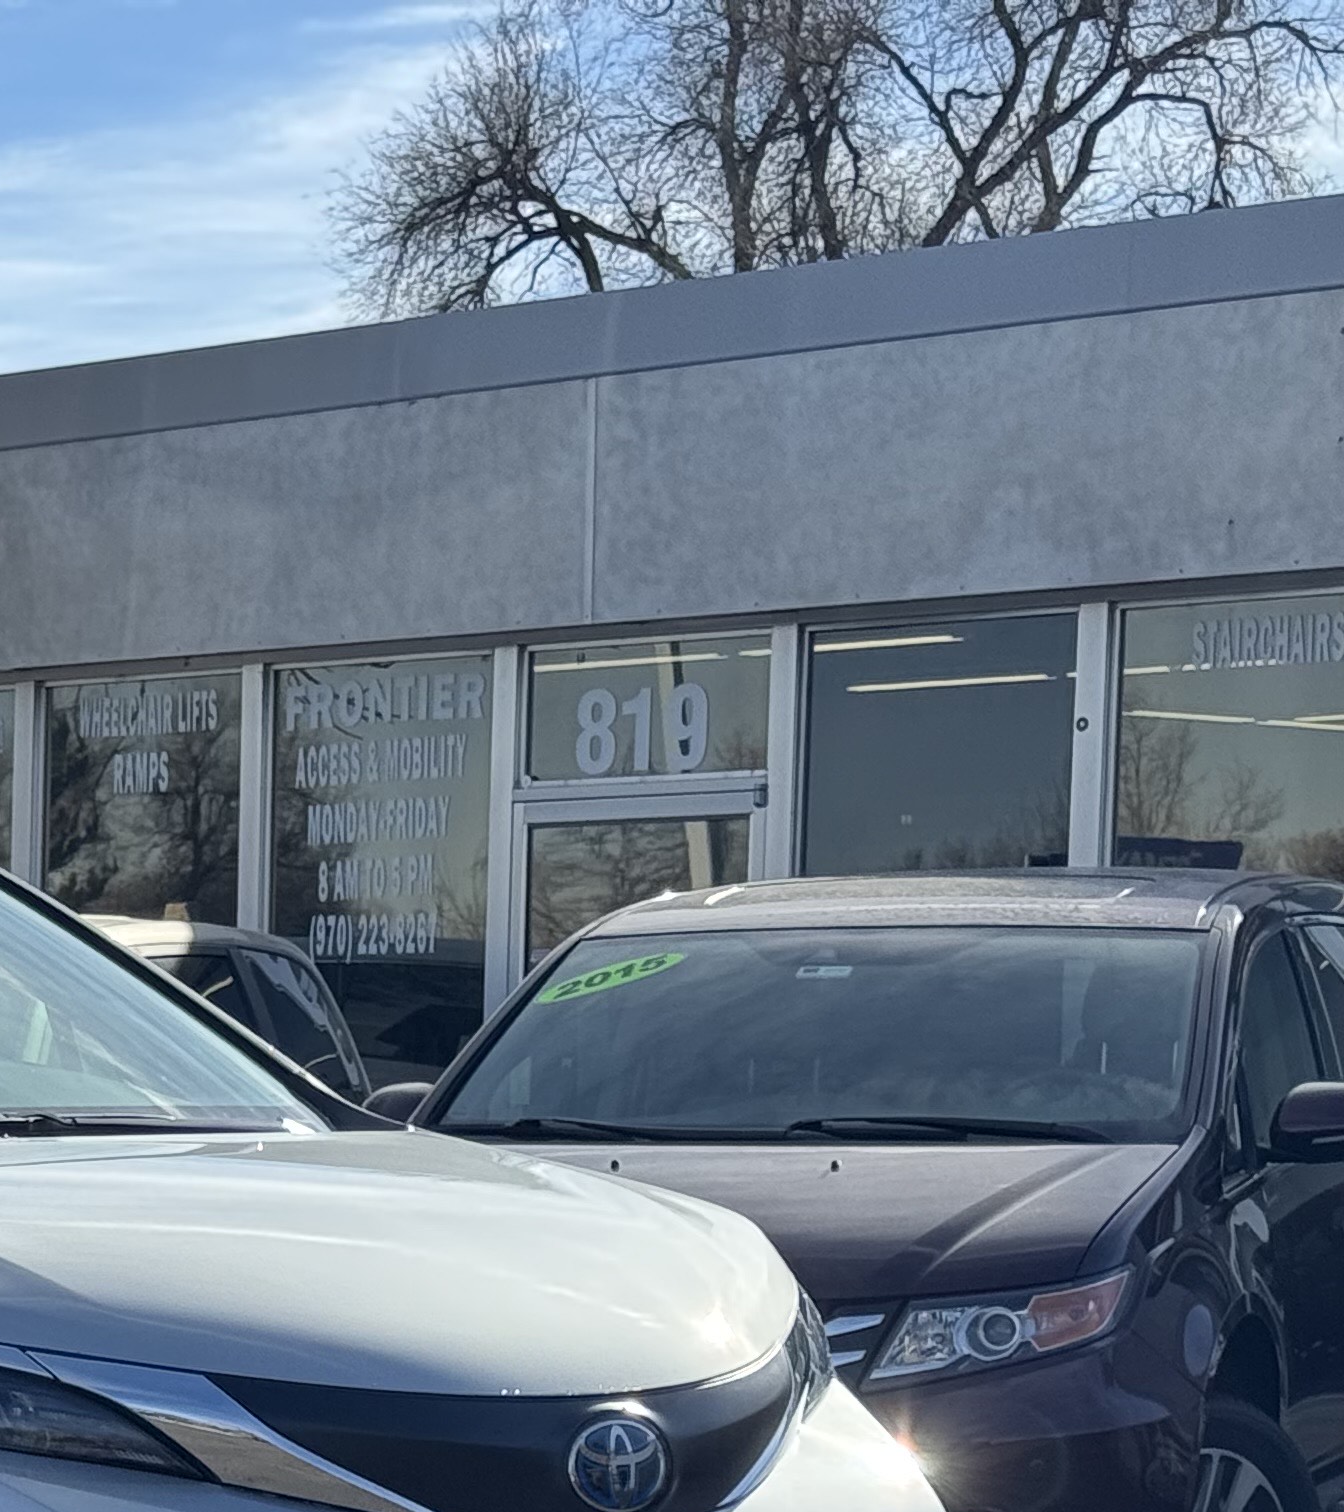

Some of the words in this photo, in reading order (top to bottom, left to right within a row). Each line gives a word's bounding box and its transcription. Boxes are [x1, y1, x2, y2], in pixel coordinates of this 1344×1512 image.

[1191, 612, 1344, 669] STAIRCHAIRS
[79, 694, 173, 738] WHEELCHAIR
[178, 688, 218, 733] LIFTS
[286, 673, 485, 731] FRONTIER
[576, 682, 708, 774] 819
[113, 751, 169, 794] RAMPS
[295, 741, 361, 789] ACCESS
[367, 740, 379, 782] &
[384, 733, 467, 781] MOBILITY
[308, 796, 450, 846] MONDAY-FRIDAY
[318, 860, 329, 902] 8
[333, 858, 359, 901] AM
[363, 857, 386, 898] TO
[392, 857, 402, 896] 5
[408, 853, 434, 896] PM
[310, 914, 353, 964] (970)
[358, 911, 437, 956] 223-8267
[554, 954, 668, 999] 2015
